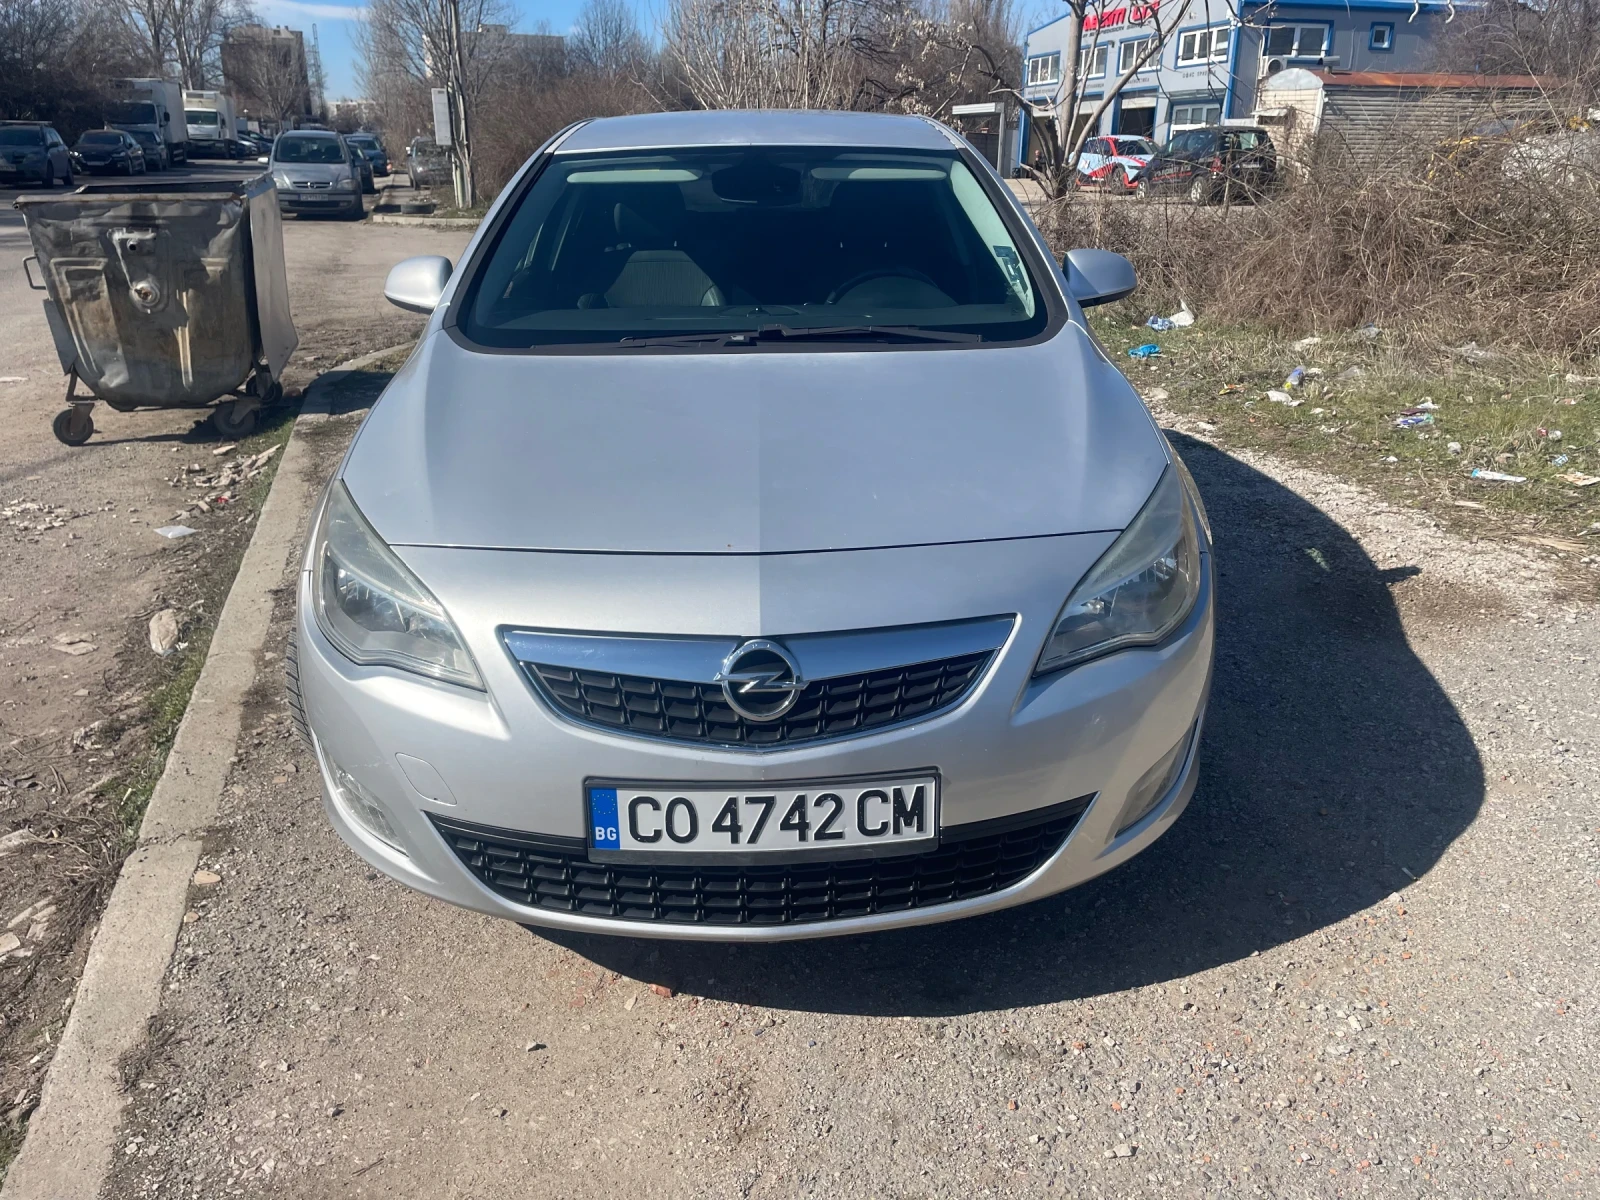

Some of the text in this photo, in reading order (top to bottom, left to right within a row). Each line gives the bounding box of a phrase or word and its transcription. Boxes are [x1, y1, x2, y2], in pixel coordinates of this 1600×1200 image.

[595, 826, 617, 841] BG
[627, 785, 926, 845] CO 4742 CM
